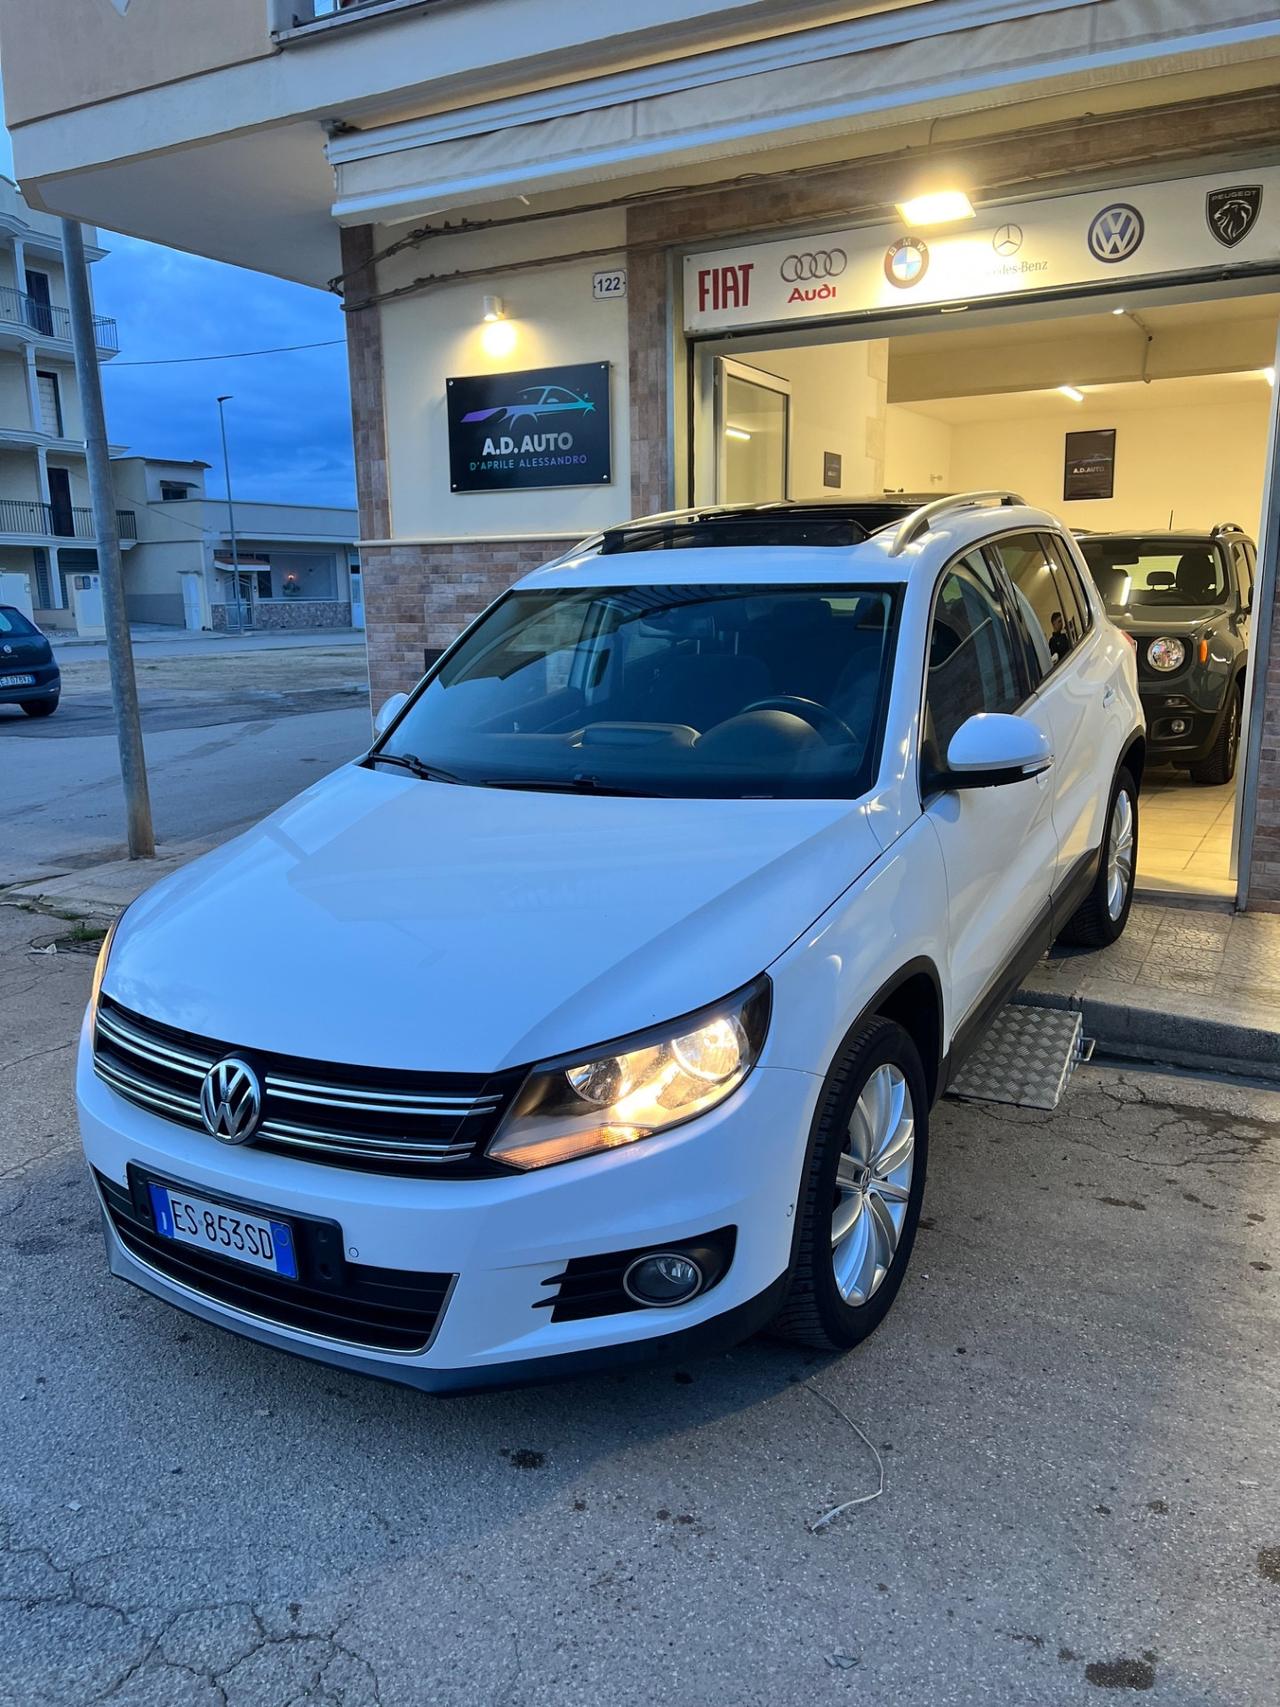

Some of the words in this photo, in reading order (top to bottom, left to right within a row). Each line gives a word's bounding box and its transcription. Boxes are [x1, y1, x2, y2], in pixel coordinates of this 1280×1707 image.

[1211, 189, 1258, 201] PEUGEOT
[888, 238, 928, 257] BMW
[596, 277, 621, 293] 122
[698, 263, 754, 312] FIAT
[787, 284, 837, 304] Audi
[470, 459, 515, 472] D'APRILE
[519, 455, 588, 469] ALESSANDRO
[171, 1199, 199, 1236] ES
[203, 1210, 274, 1260] 853SD
